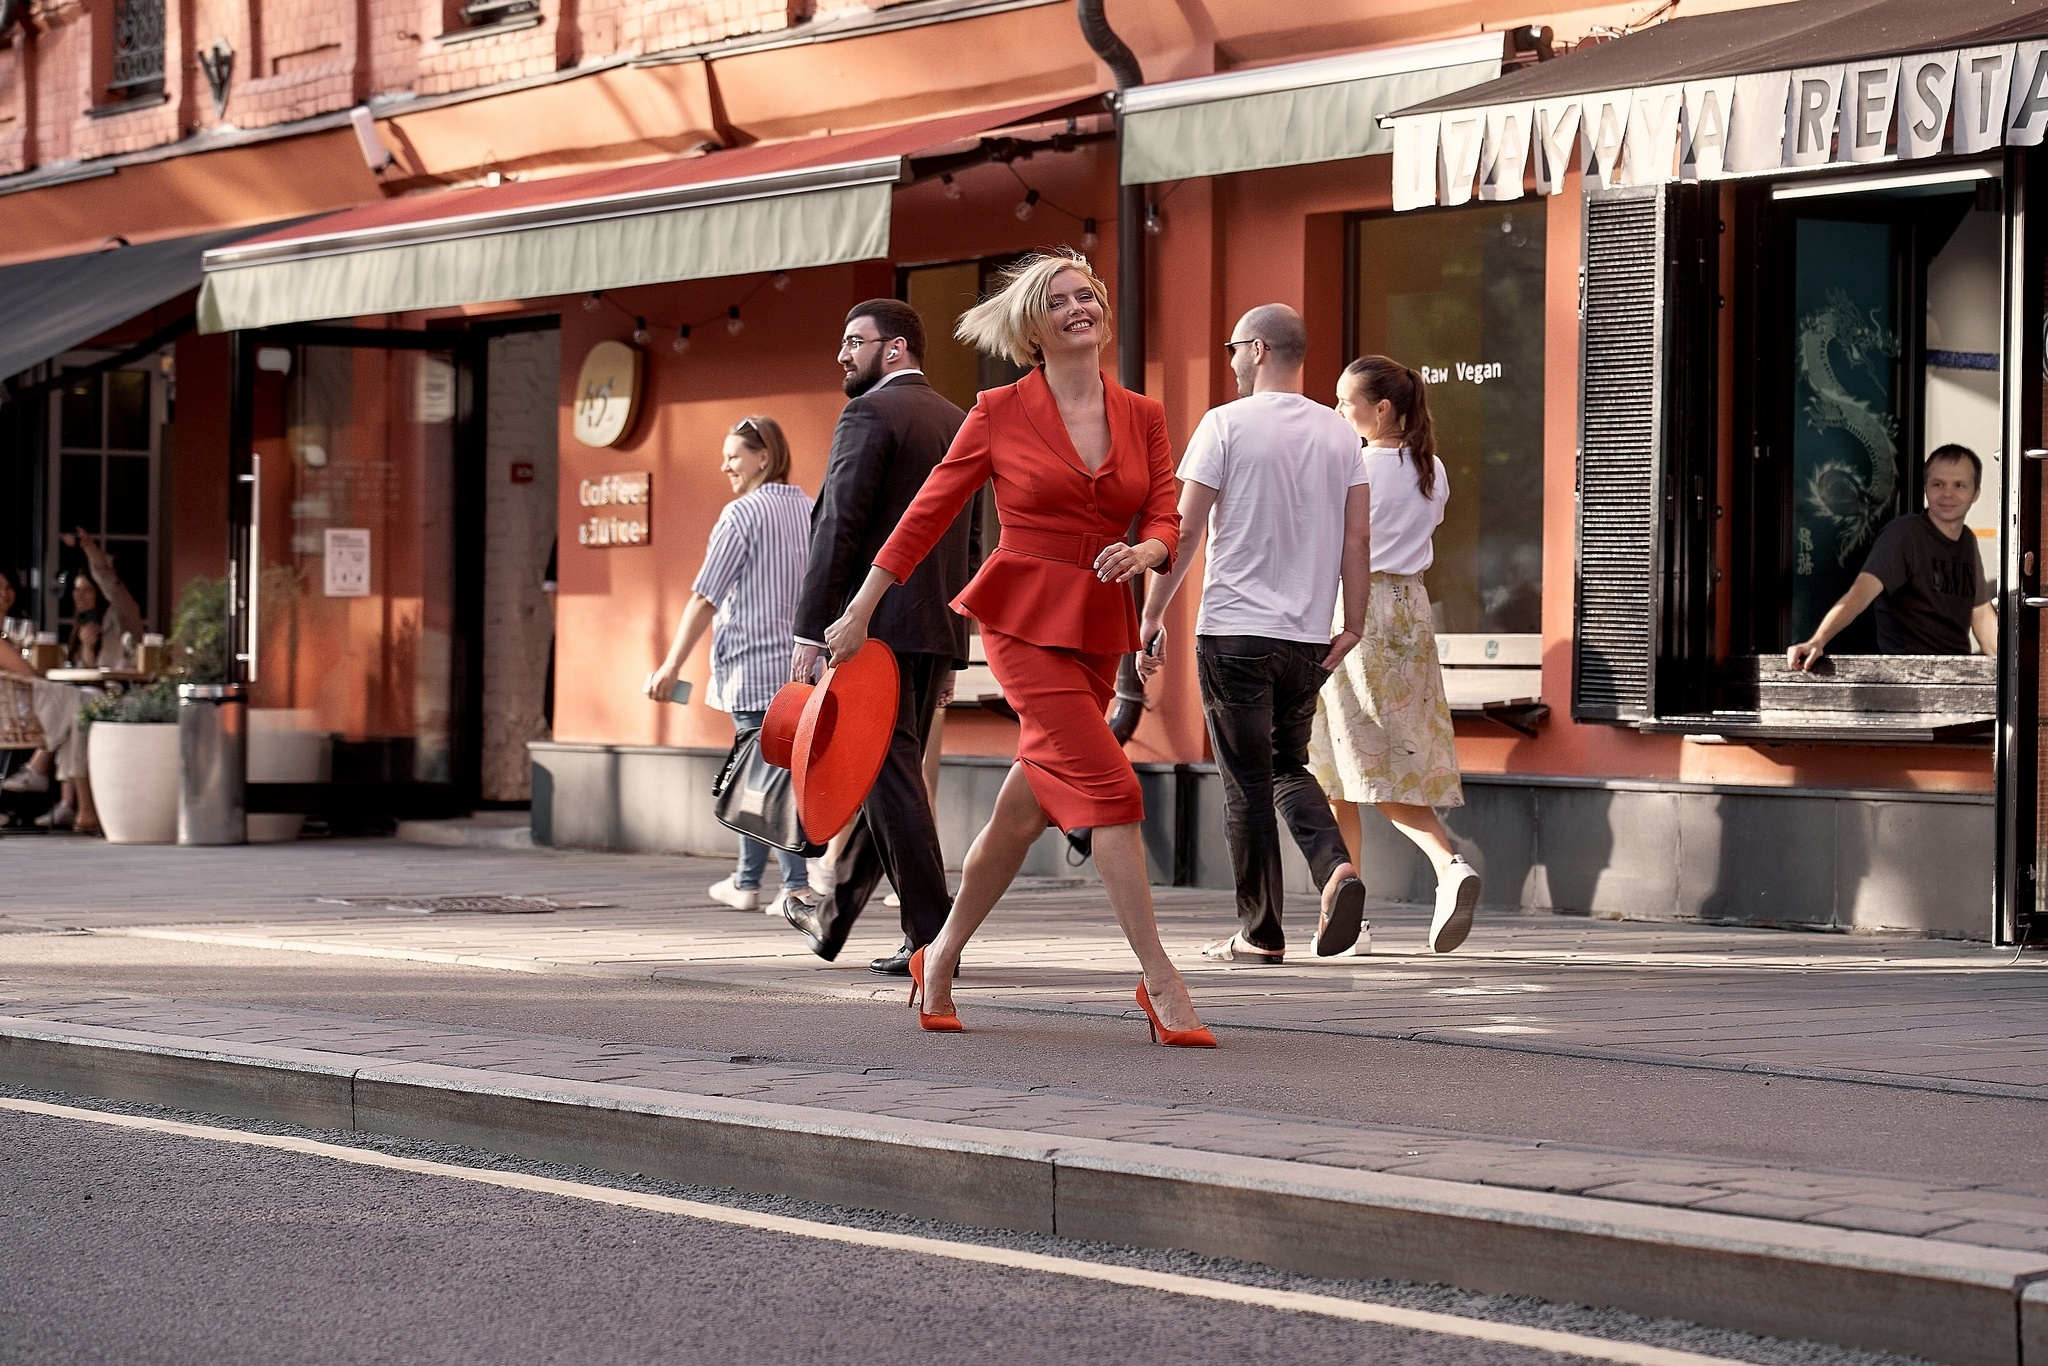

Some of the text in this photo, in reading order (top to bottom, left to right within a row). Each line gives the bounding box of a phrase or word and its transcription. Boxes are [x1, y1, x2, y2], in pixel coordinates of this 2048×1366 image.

[1413, 90, 1725, 191] IZAKAYA
[1421, 361, 1502, 385] Raw Vegan
